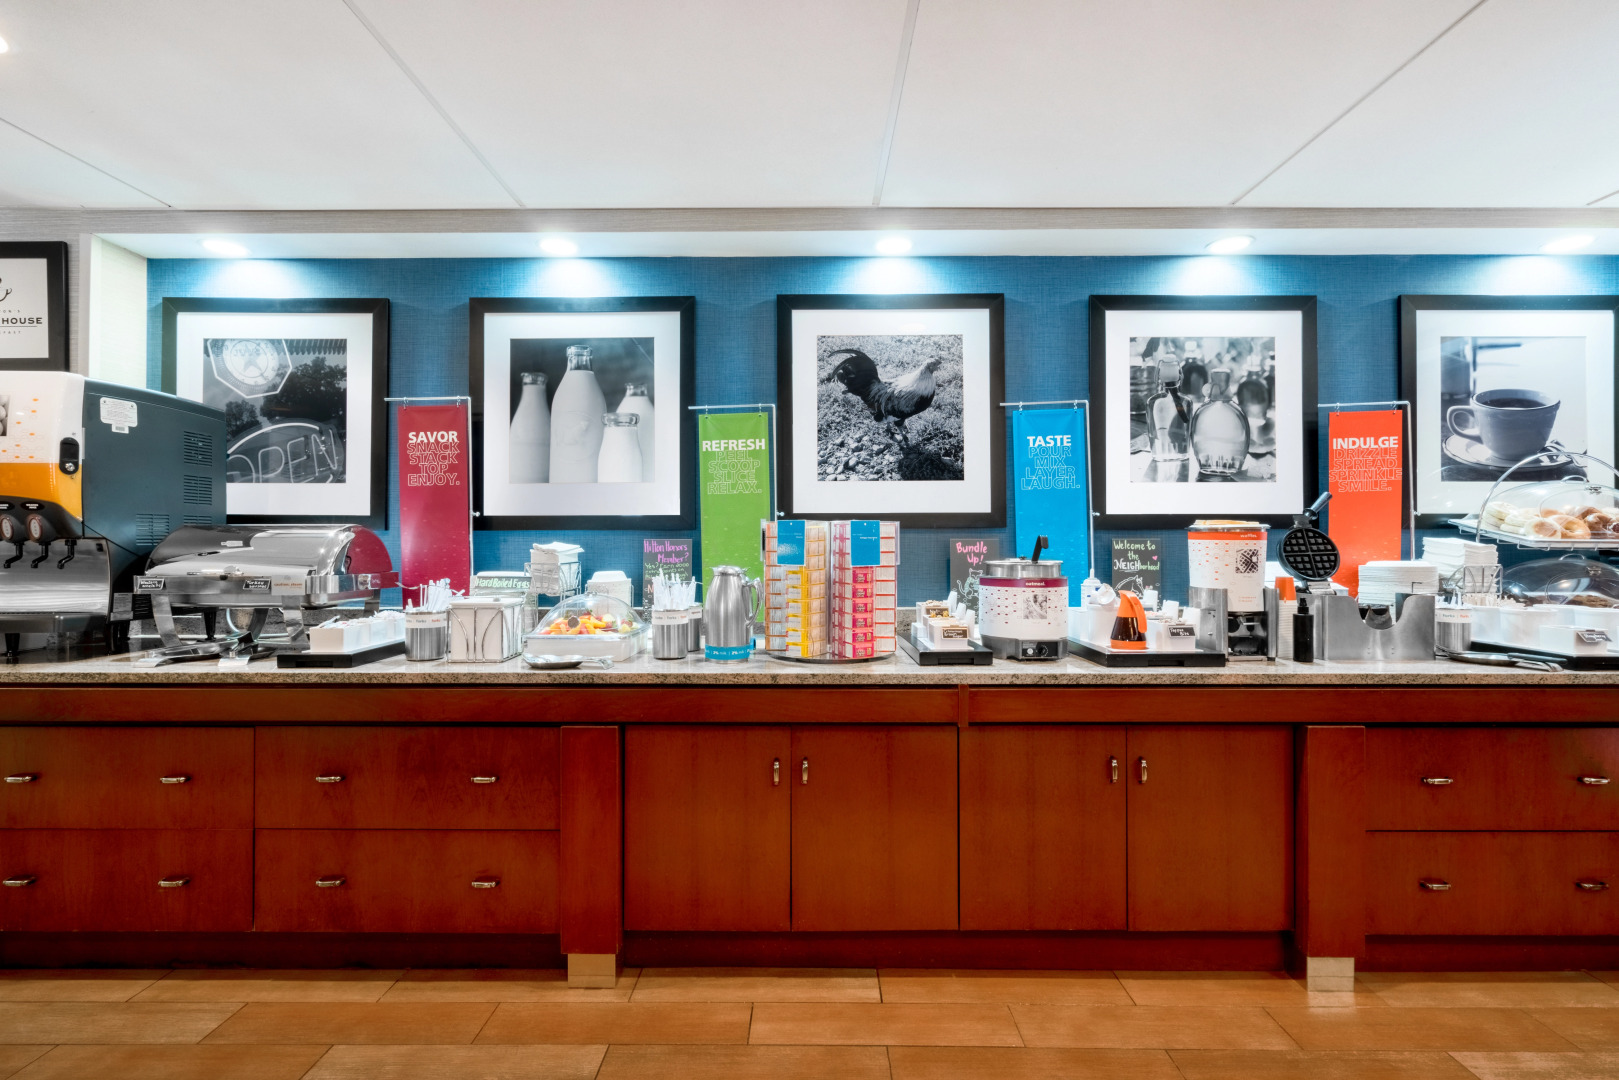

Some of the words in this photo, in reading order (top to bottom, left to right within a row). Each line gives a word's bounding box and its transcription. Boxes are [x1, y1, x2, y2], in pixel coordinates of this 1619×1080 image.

[1, 317, 43, 325] HOUSE
[408, 431, 459, 443] SAVOR
[1026, 435, 1072, 447] TASTE
[1332, 436, 1399, 450] INDULGE
[406, 441, 460, 454] SNACK
[702, 438, 766, 452] REFRESH
[1028, 445, 1072, 458] POUR
[409, 452, 458, 465] STACK
[715, 448, 753, 462] PEEL
[1333, 447, 1398, 460] DRIZZLE
[419, 462, 449, 475] TOP
[708, 460, 761, 473] SCOOP
[1034, 455, 1067, 469] MIX
[1333, 458, 1398, 471] SPREAD
[713, 471, 756, 484] SLICE
[1025, 466, 1076, 479] LAYER
[1329, 468, 1402, 482] SPRINKLE
[408, 473, 460, 486] ENJOY.
[1021, 477, 1081, 490] LAUGH.
[707, 481, 763, 494] RELAX.
[1338, 480, 1393, 493] SMILE.
[665, 540, 687, 552] Honors
[956, 541, 988, 553] Bundle
[1113, 539, 1145, 551] Welcome
[1146, 540, 1156, 551] to
[657, 552, 689, 563] Member?
[967, 553, 984, 566] Up!
[1127, 550, 1139, 560] the
[512, 578, 530, 589] Eggs
